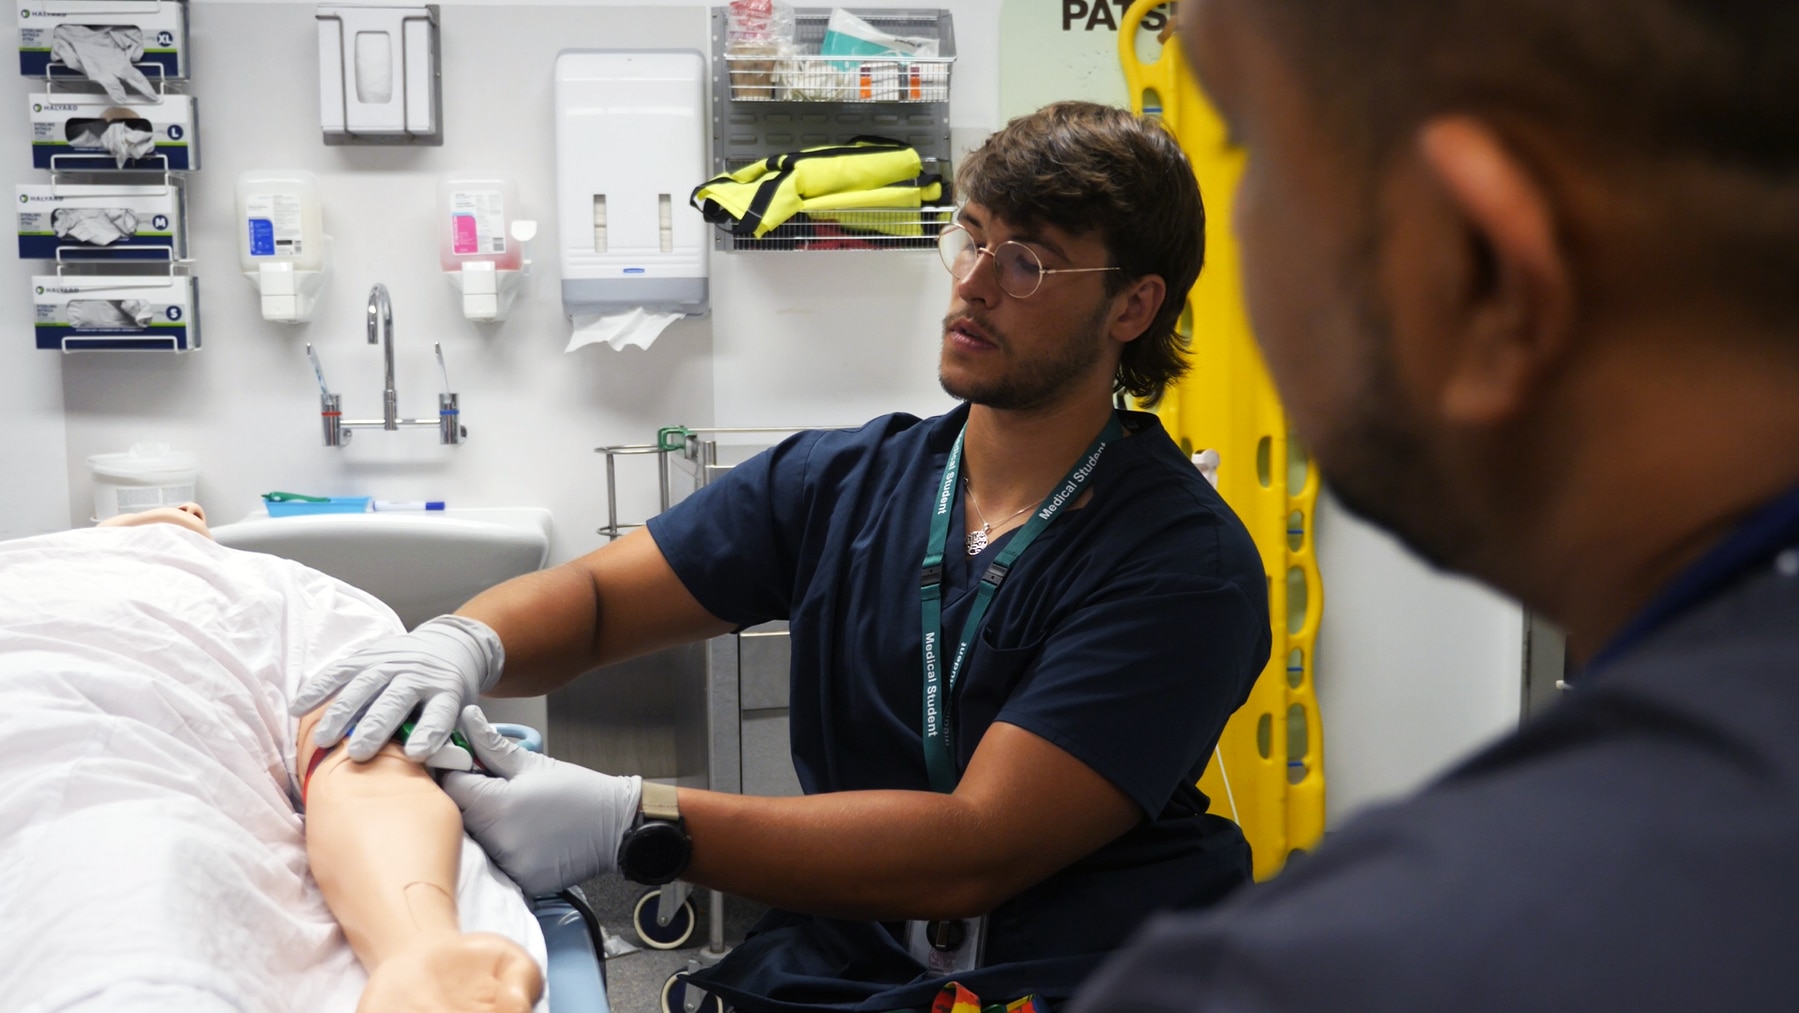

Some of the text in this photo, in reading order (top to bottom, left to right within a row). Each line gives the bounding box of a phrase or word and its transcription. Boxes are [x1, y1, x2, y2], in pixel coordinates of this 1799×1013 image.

[1063, 0, 1168, 31] PATS
[157, 33, 173, 45] XL
[170, 127, 180, 138] L
[154, 217, 167, 228] M
[169, 308, 179, 319] S
[938, 471, 955, 515] Student
[1038, 480, 1078, 520] Medical
[925, 631, 938, 738] Medical Student
